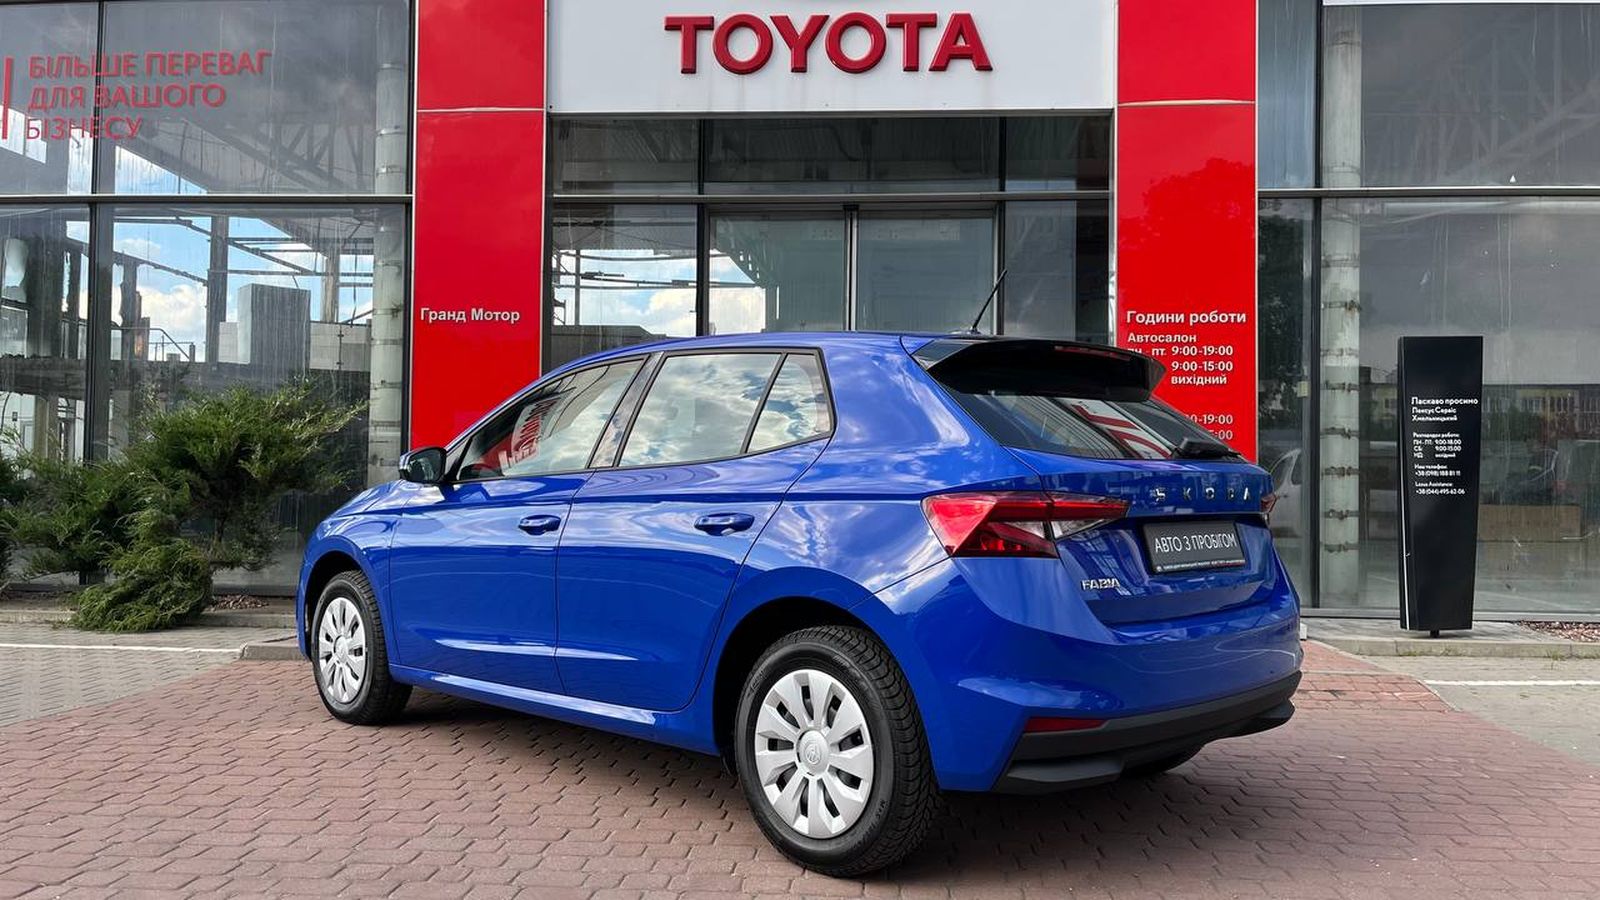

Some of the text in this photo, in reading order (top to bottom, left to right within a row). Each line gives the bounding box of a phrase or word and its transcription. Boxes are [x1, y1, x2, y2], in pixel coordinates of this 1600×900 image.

[664, 12, 993, 75] TOYOTA
[29, 49, 271, 79] БІЛЬШЕ ПЕРЕВАГ
[28, 83, 227, 111] ДЛЯ ВАШОГО
[420, 307, 520, 324] Гранд Мотор
[1126, 310, 1247, 326] Години роботи
[1127, 332, 1197, 343] Автосалон
[1171, 345, 1234, 356] 9:00-19:00
[1171, 361, 1234, 372] 9:00-15:00
[1170, 374, 1227, 386] вихідний
[1154, 536, 1182, 553] АВТО
[1191, 533, 1238, 551] ПРОБІГОМ
